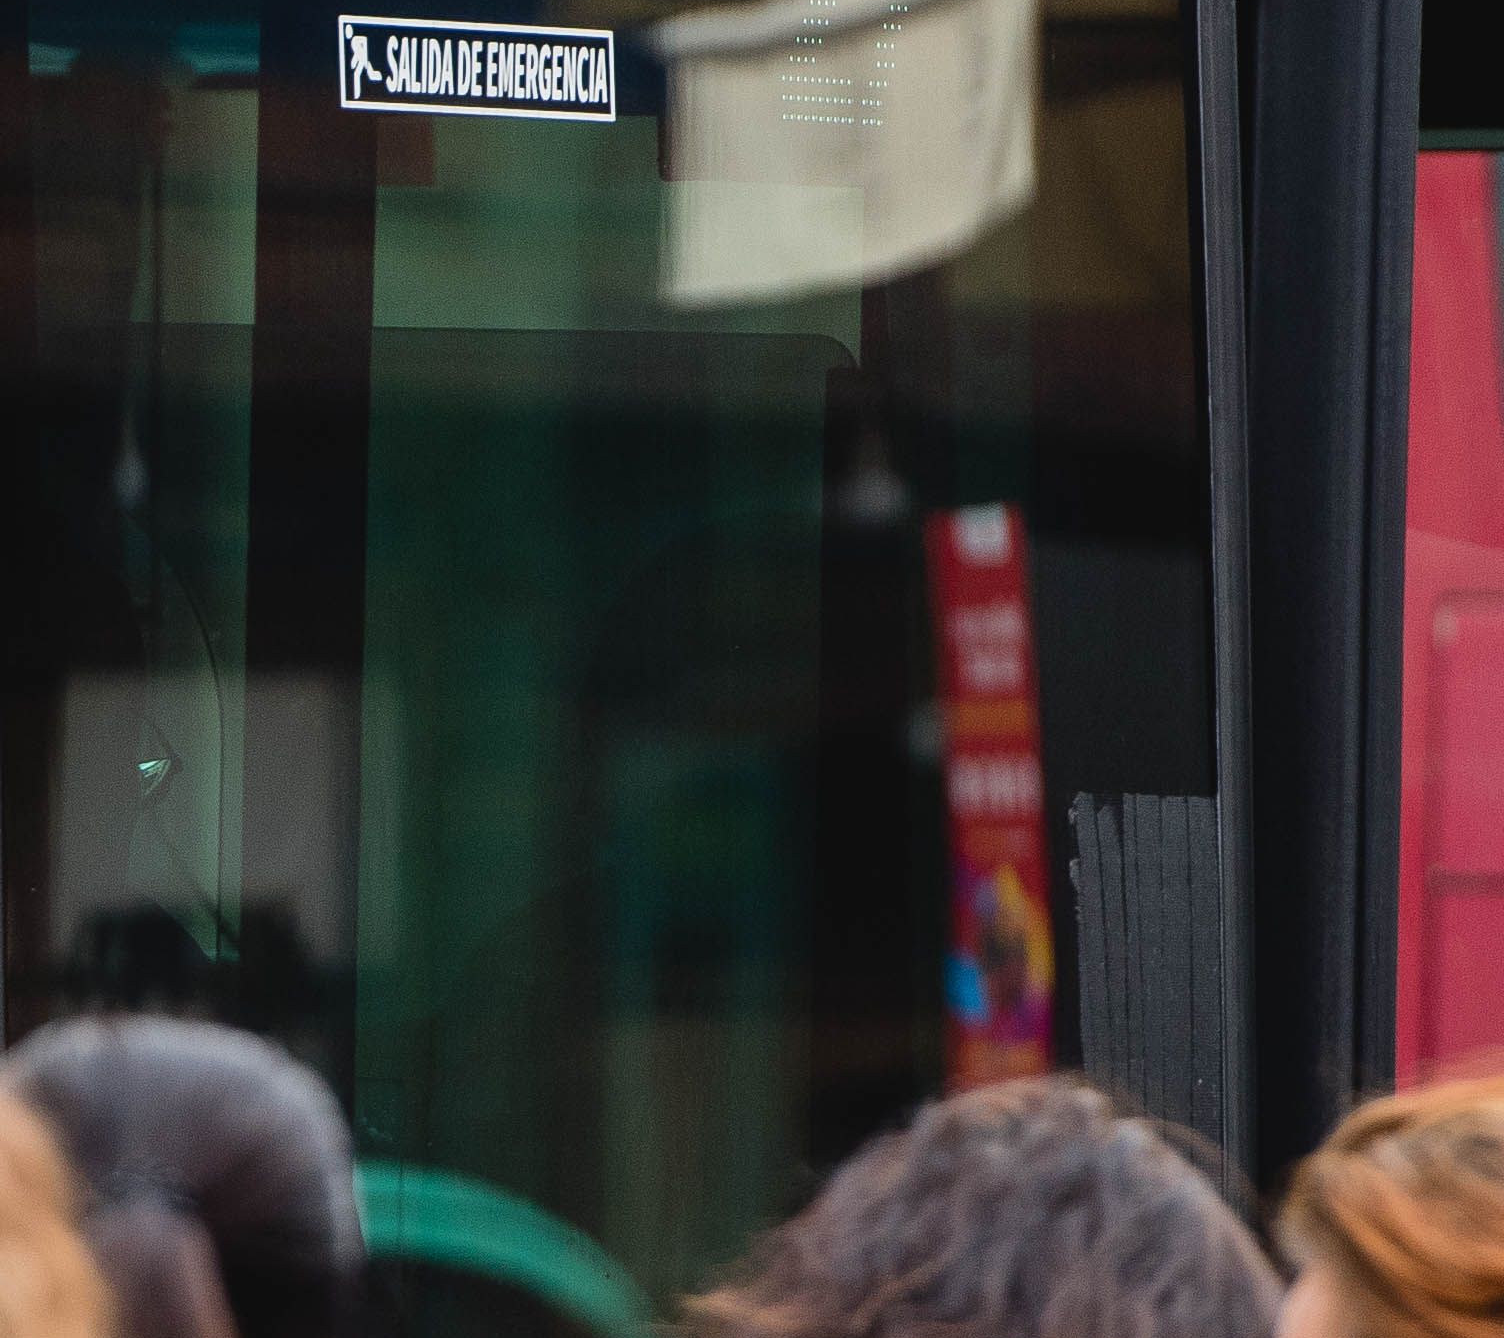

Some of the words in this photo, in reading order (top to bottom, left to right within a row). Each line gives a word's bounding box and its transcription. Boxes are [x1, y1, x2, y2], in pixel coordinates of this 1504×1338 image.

[385, 35, 455, 95] SALIDA
[457, 39, 483, 97] DE
[486, 41, 609, 105] EMERGENCIA
